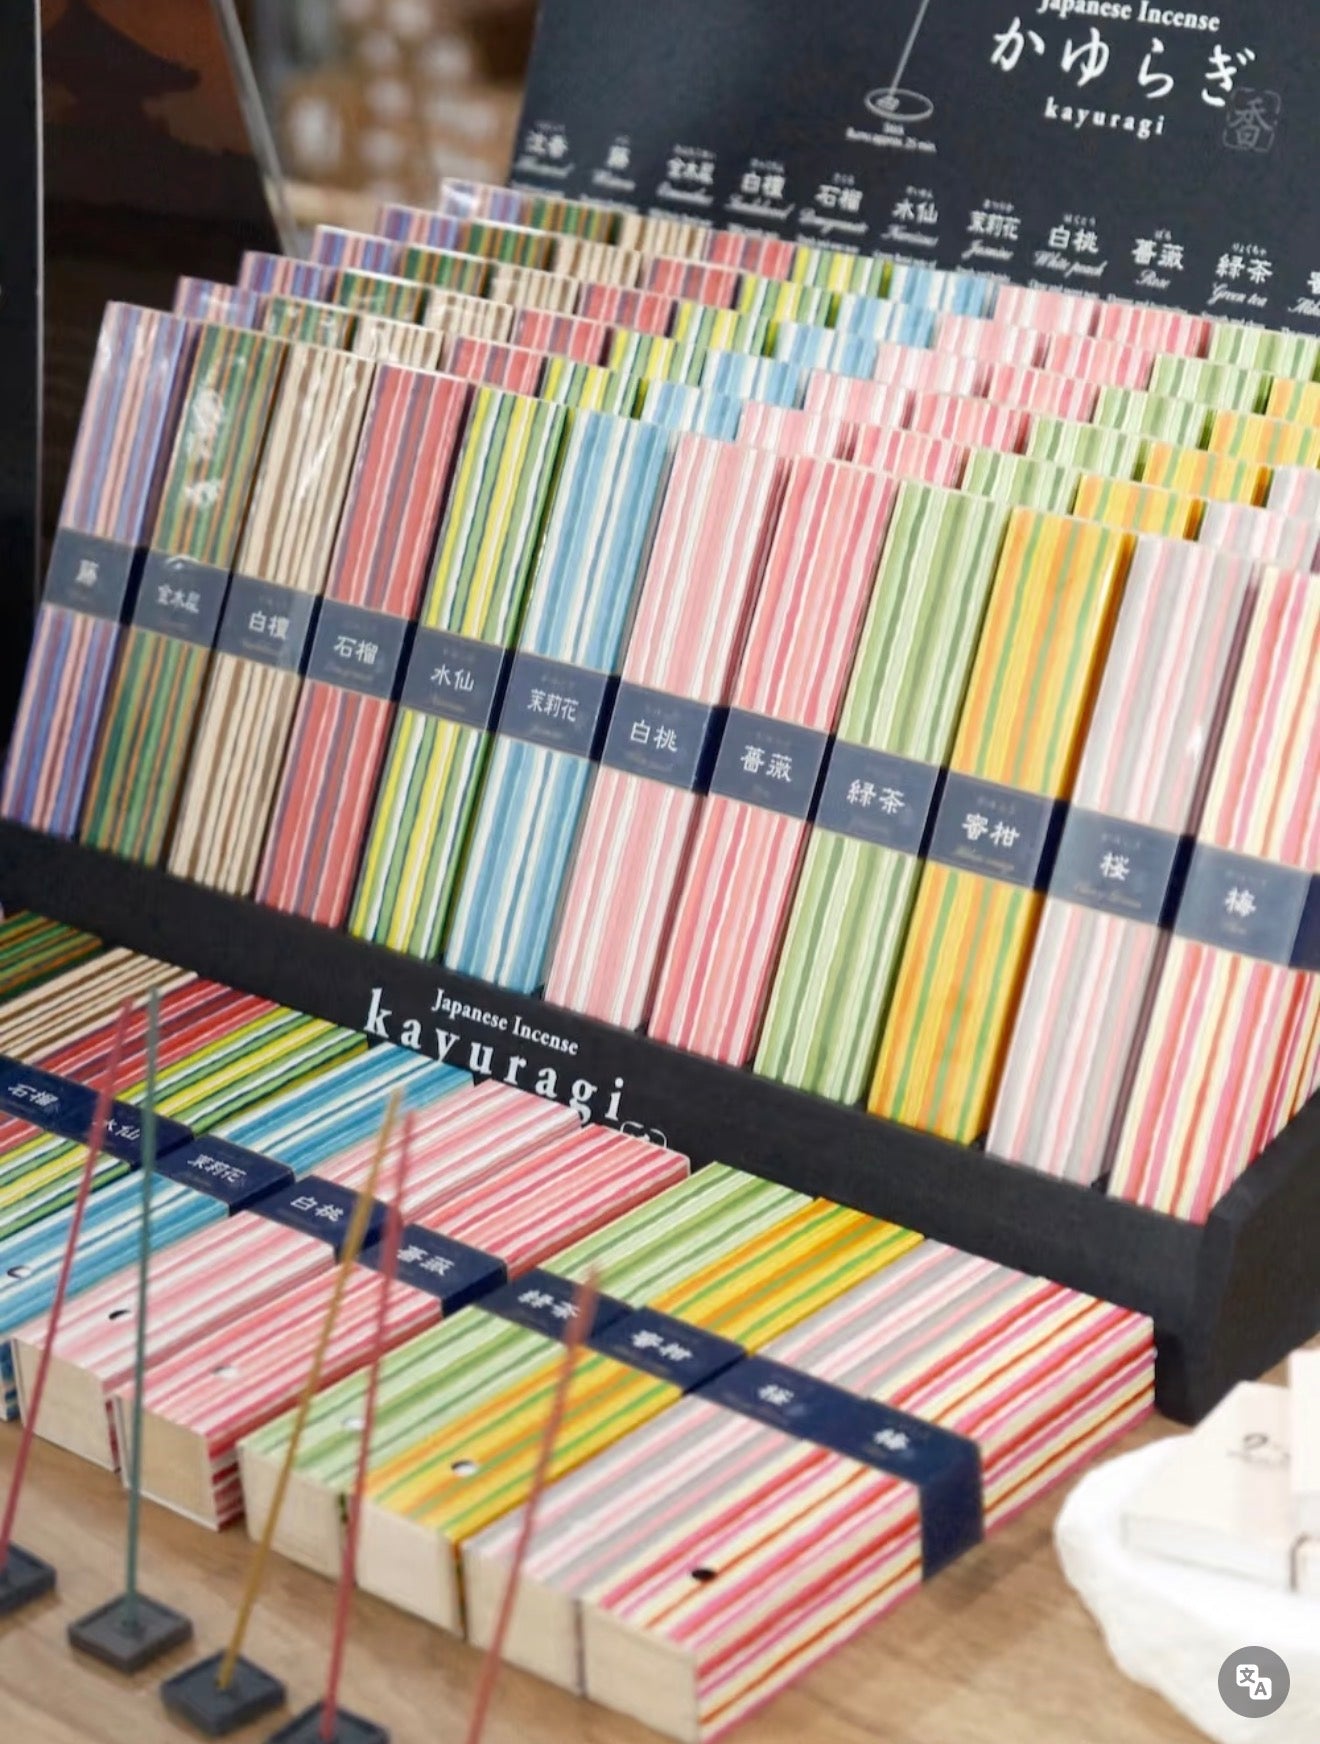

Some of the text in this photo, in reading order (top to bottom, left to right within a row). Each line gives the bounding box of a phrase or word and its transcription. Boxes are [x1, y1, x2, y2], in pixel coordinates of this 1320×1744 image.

[1036, 0, 1221, 32] Japanese Incense
[990, 16, 1256, 107] かゆらぎ
[1044, 96, 1165, 140] kayuragi
[892, 198, 939, 225] 水仙
[1048, 225, 1099, 254] 白桃
[1131, 238, 1184, 272] 薔薇
[1214, 253, 1273, 284] 緑茶
[247, 609, 291, 641] 白檀
[333, 633, 380, 666] 石榴
[429, 663, 475, 694] 水仙
[526, 687, 580, 724] 茉莉花
[629, 719, 679, 754] 白桃
[739, 744, 793, 783] 薔薇
[846, 778, 906, 816] 緑茶
[432, 987, 580, 1056] Japanese Incense
[363, 987, 625, 1125] kayuragi
